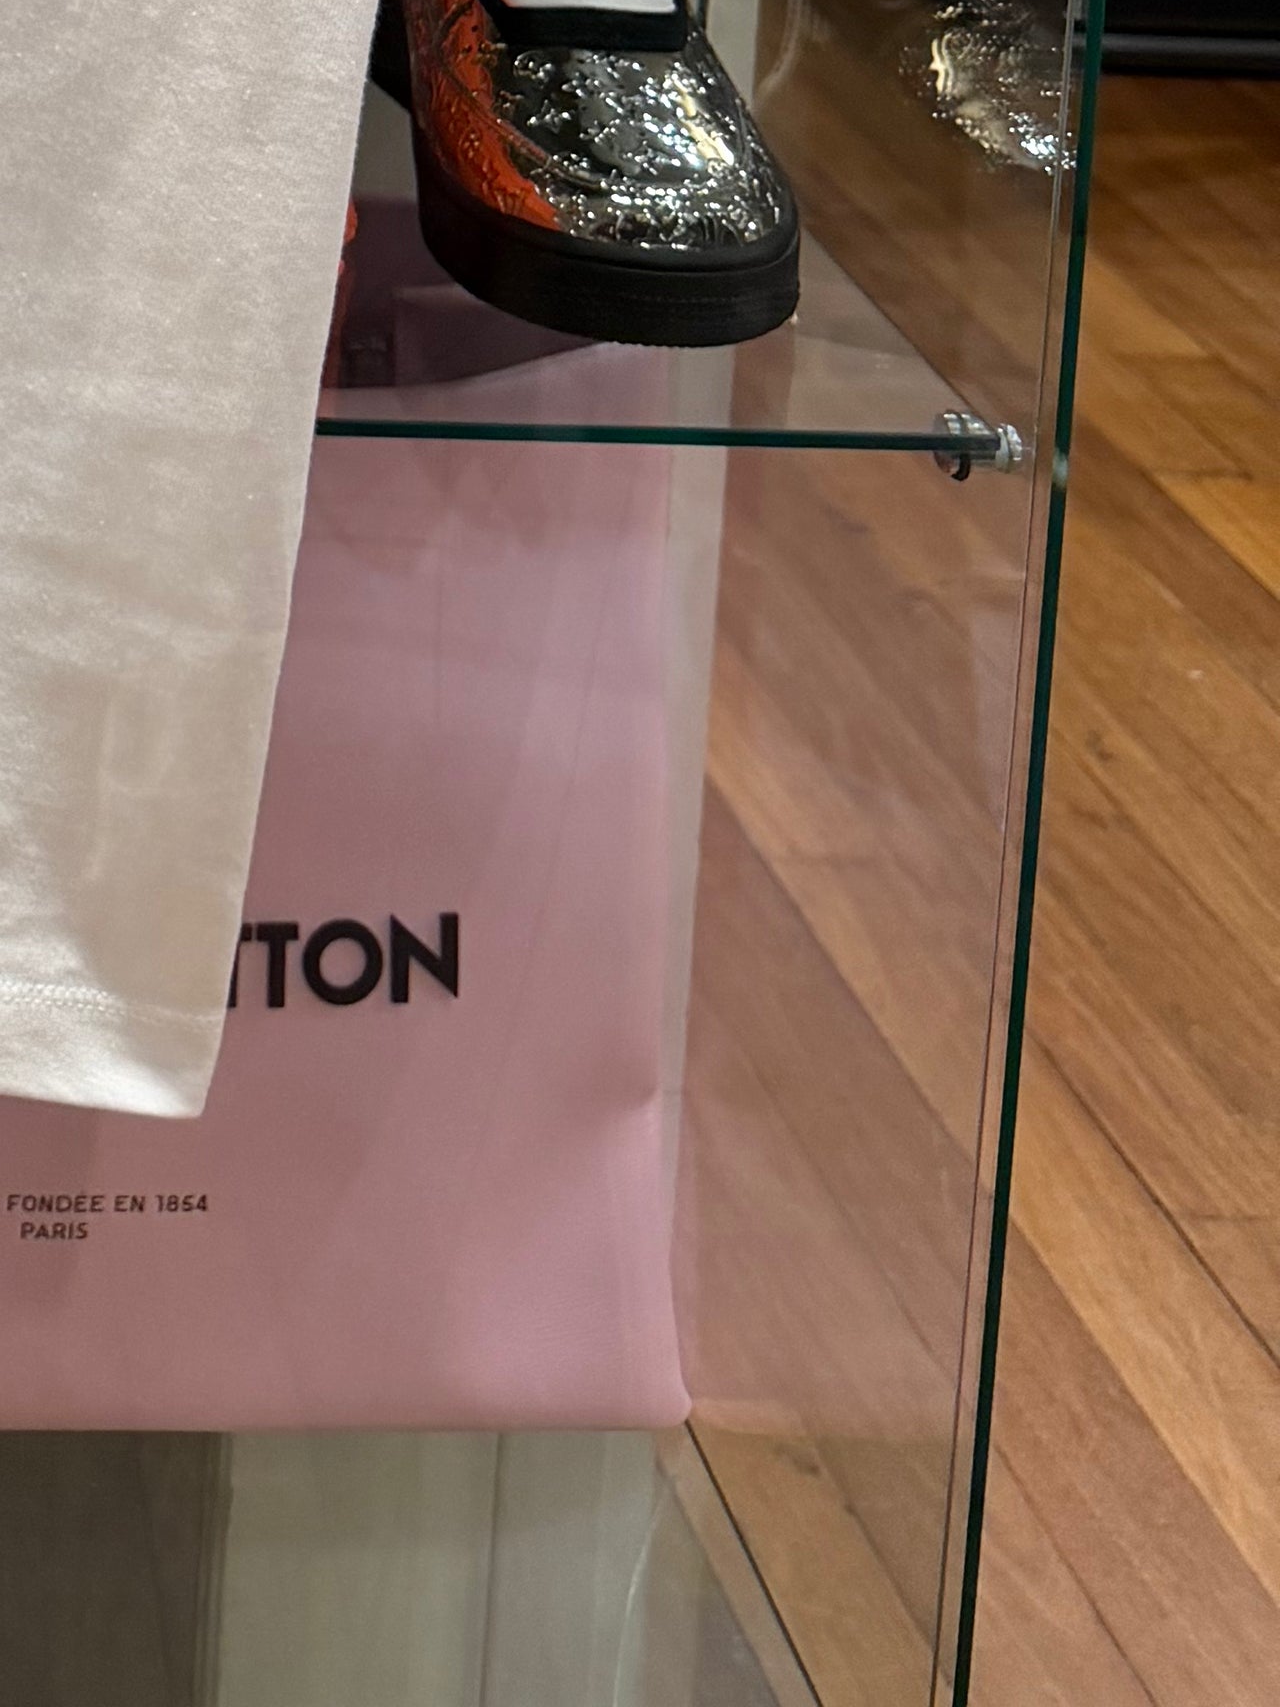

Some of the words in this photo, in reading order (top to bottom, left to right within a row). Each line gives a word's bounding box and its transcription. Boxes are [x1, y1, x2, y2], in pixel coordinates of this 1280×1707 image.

[113, 1193, 147, 1214] EN
[155, 1193, 210, 1214] 1854
[19, 1221, 90, 1241] PARIS
